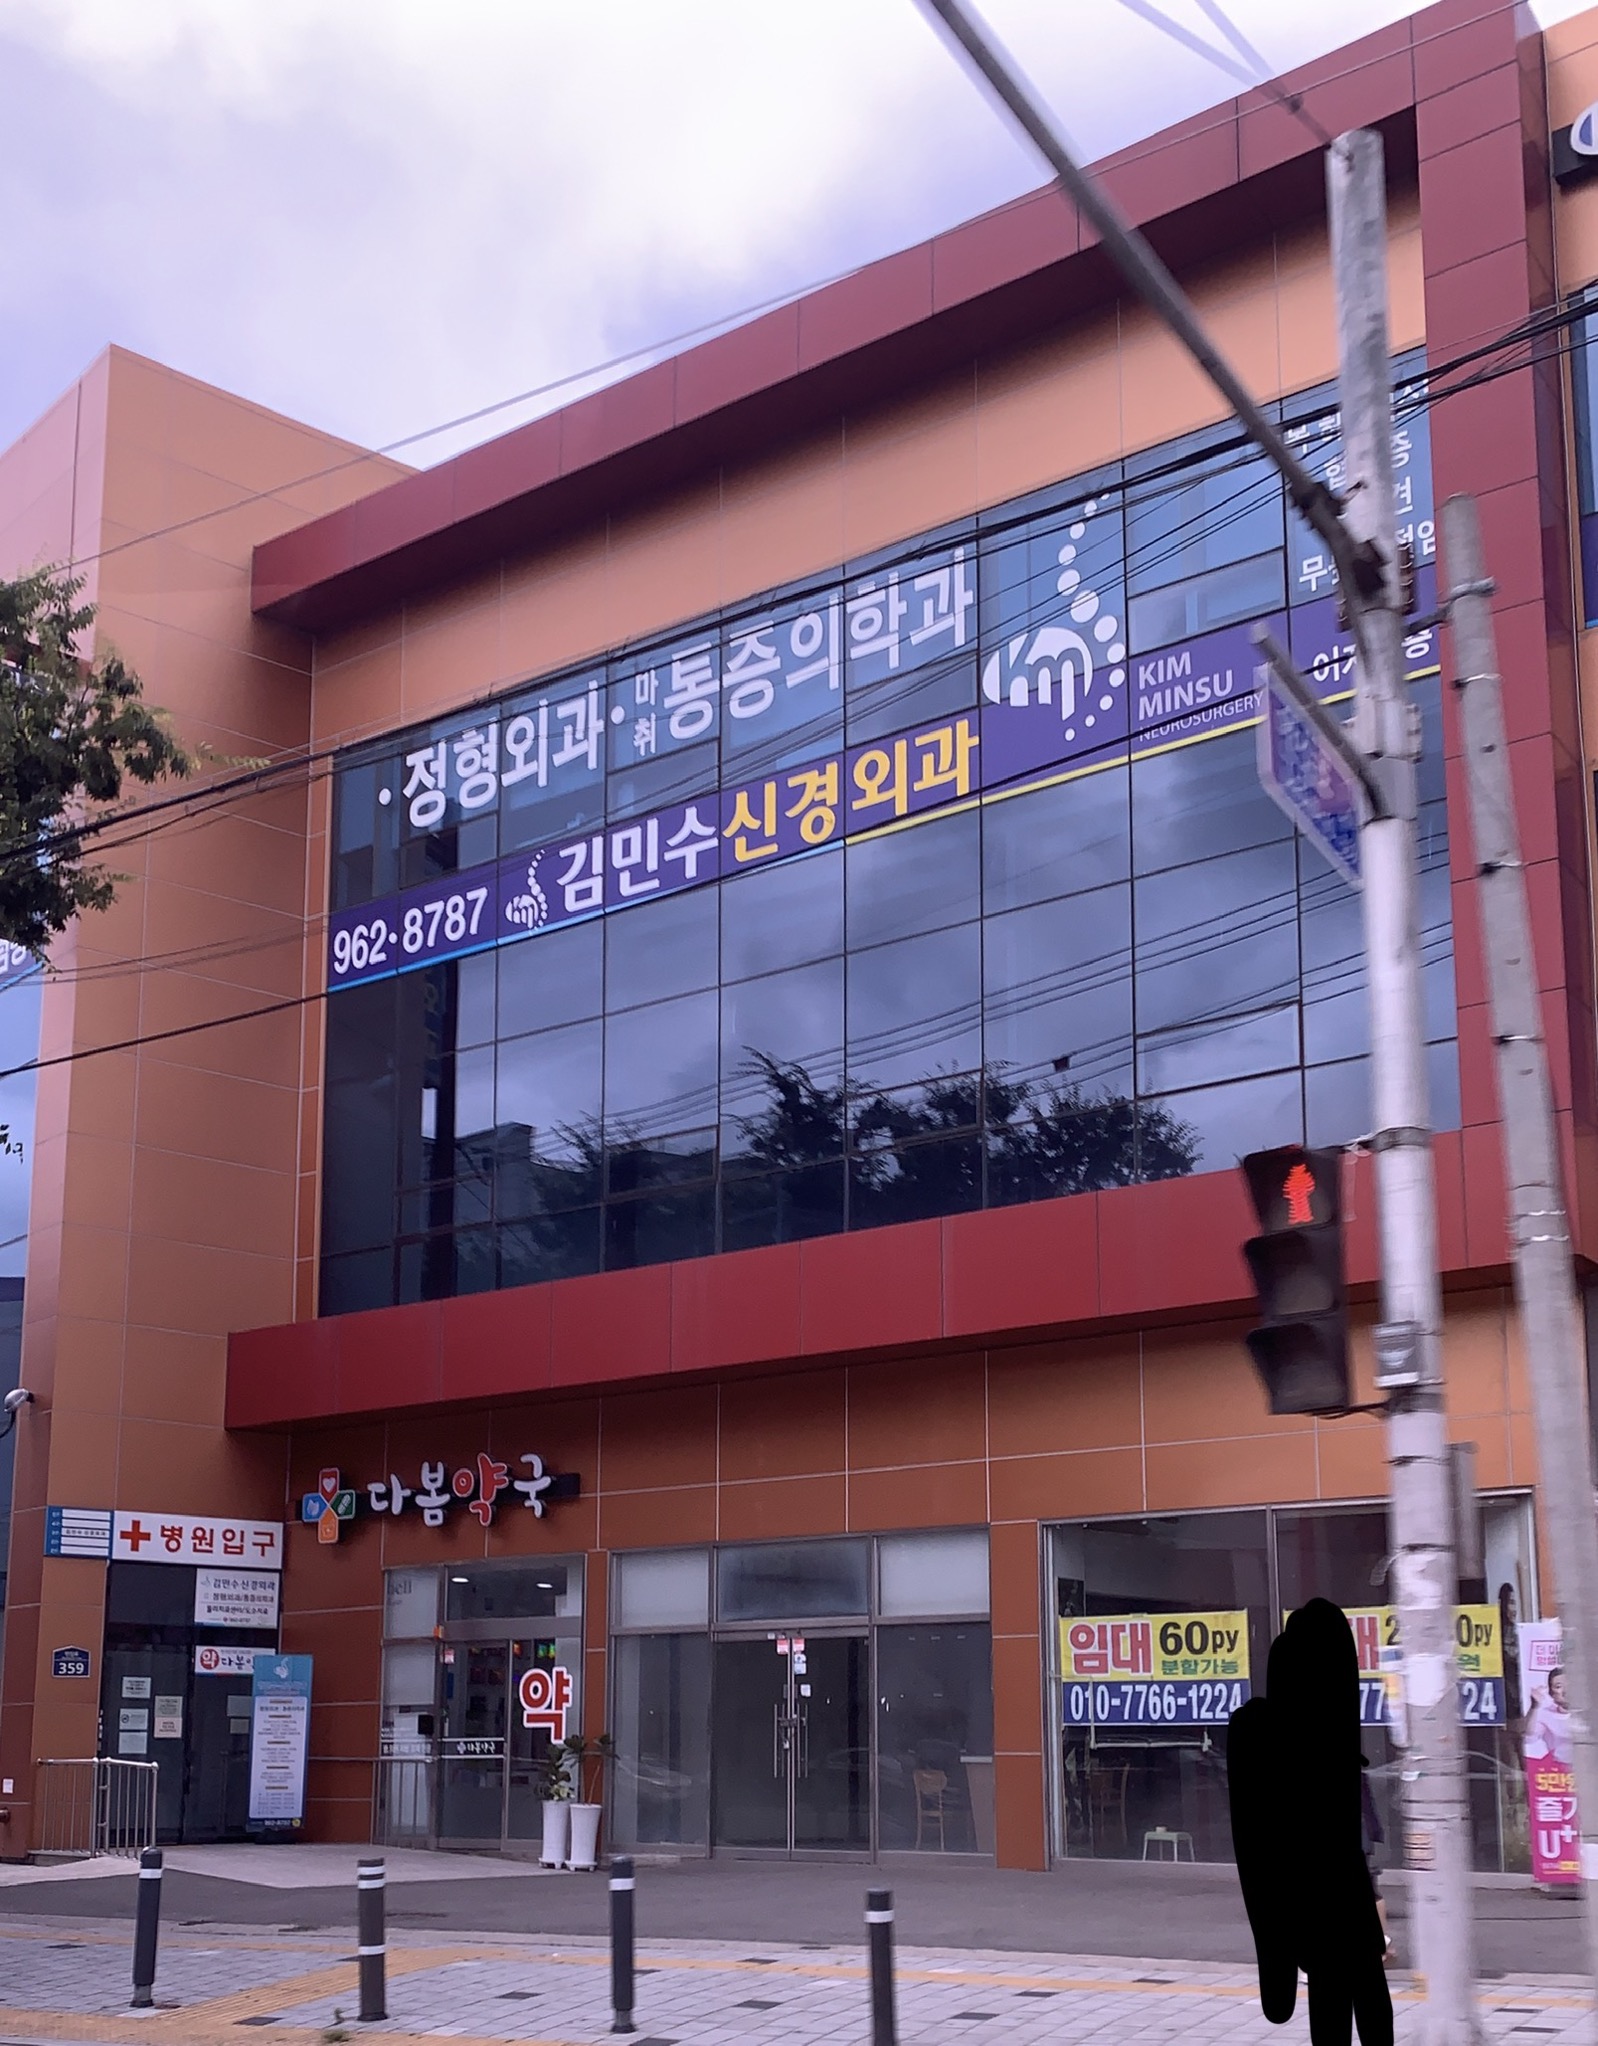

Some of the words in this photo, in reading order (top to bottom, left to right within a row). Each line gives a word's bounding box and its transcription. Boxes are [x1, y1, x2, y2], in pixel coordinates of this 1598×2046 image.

[1138, 651, 1192, 690] KIM
[1138, 669, 1233, 721] MINSU
[1139, 690, 1264, 742] NEUROSURGERY
[367, 1452, 551, 1527] 다봄약국
[160, 1525, 275, 1557] 병원입구
[59, 1662, 85, 1674] 359
[1069, 1621, 1153, 1676] 임대
[1159, 1620, 1239, 1656] 60py
[1161, 1659, 1239, 1675] 분할가능
[519, 1666, 573, 1744] 약
[1070, 1683, 1243, 1721] 010-7766-1224
